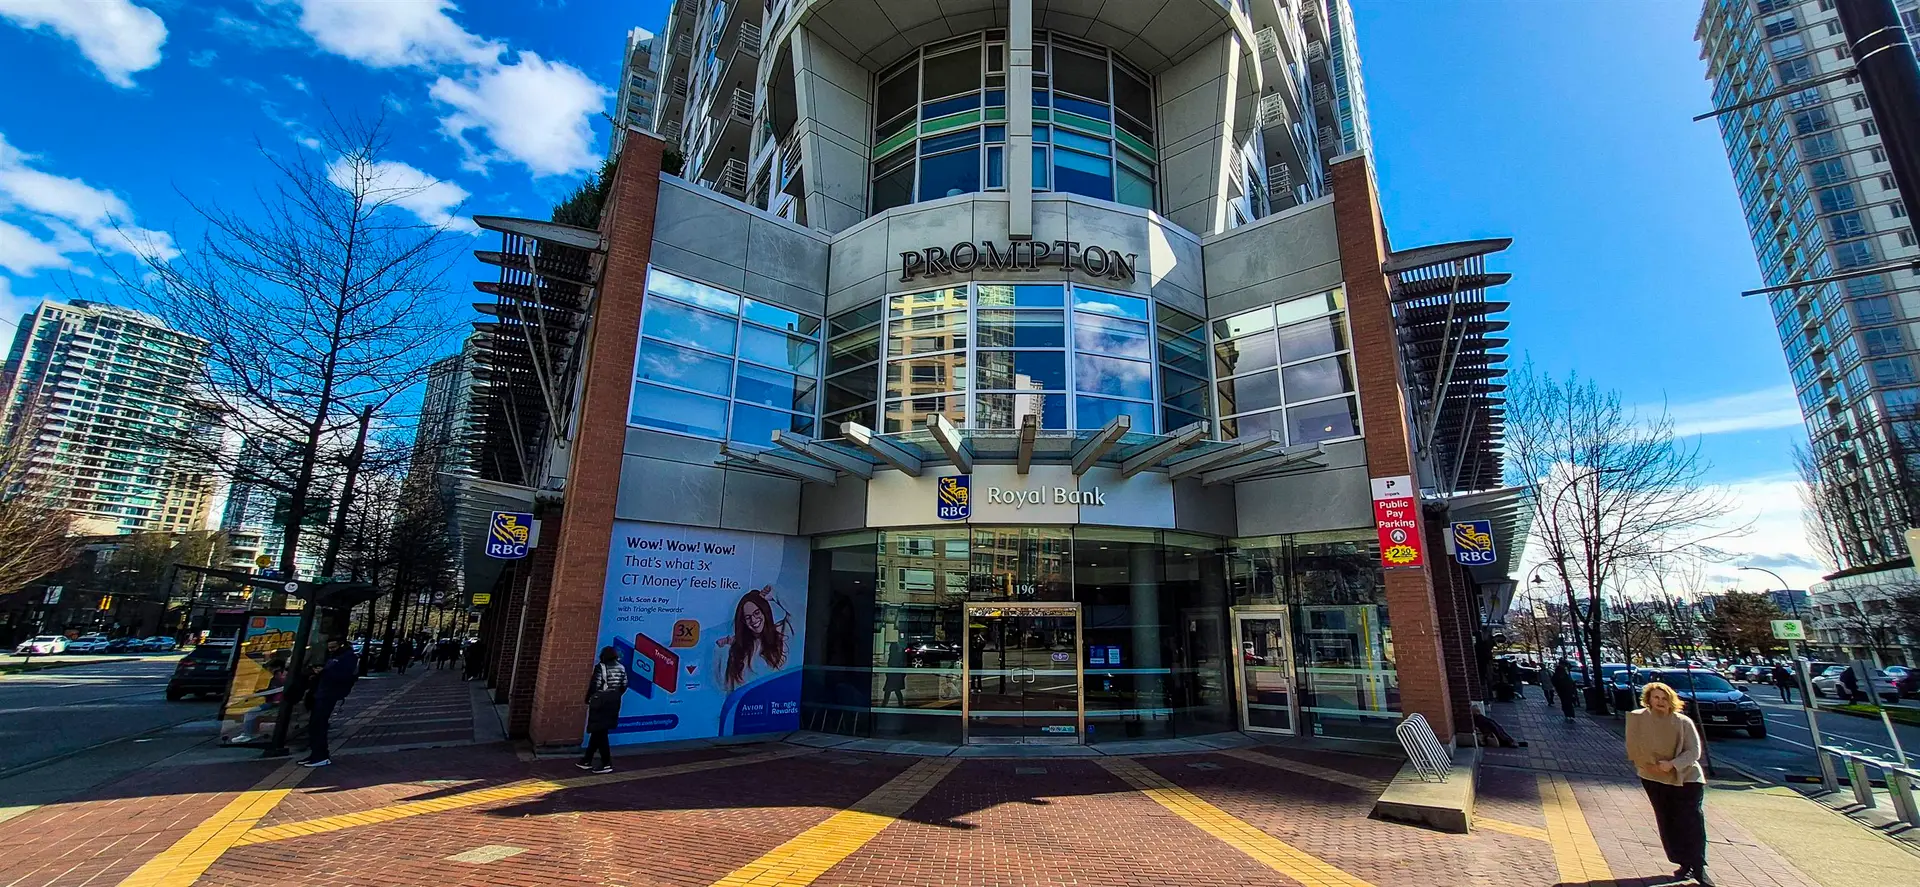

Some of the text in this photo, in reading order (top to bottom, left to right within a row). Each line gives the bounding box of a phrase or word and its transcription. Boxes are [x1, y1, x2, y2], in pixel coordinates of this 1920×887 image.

[899, 240, 1139, 284] PROMPTON
[987, 486, 1106, 509] Royal Bank
[1379, 500, 1409, 509] Public
[940, 506, 967, 517] RBC
[1386, 510, 1404, 519] Pay
[1378, 520, 1415, 529] Parking
[491, 543, 525, 555] RBC
[626, 536, 736, 555] Wow! Wow! Wow!
[1459, 551, 1492, 561] RBC
[624, 555, 662, 568] That's
[665, 558, 695, 570] what
[621, 573, 639, 585] CT
[690, 576, 717, 589] feels
[720, 577, 742, 590] like.
[658, 597, 670, 605] Pay
[633, 606, 656, 614] Triangle
